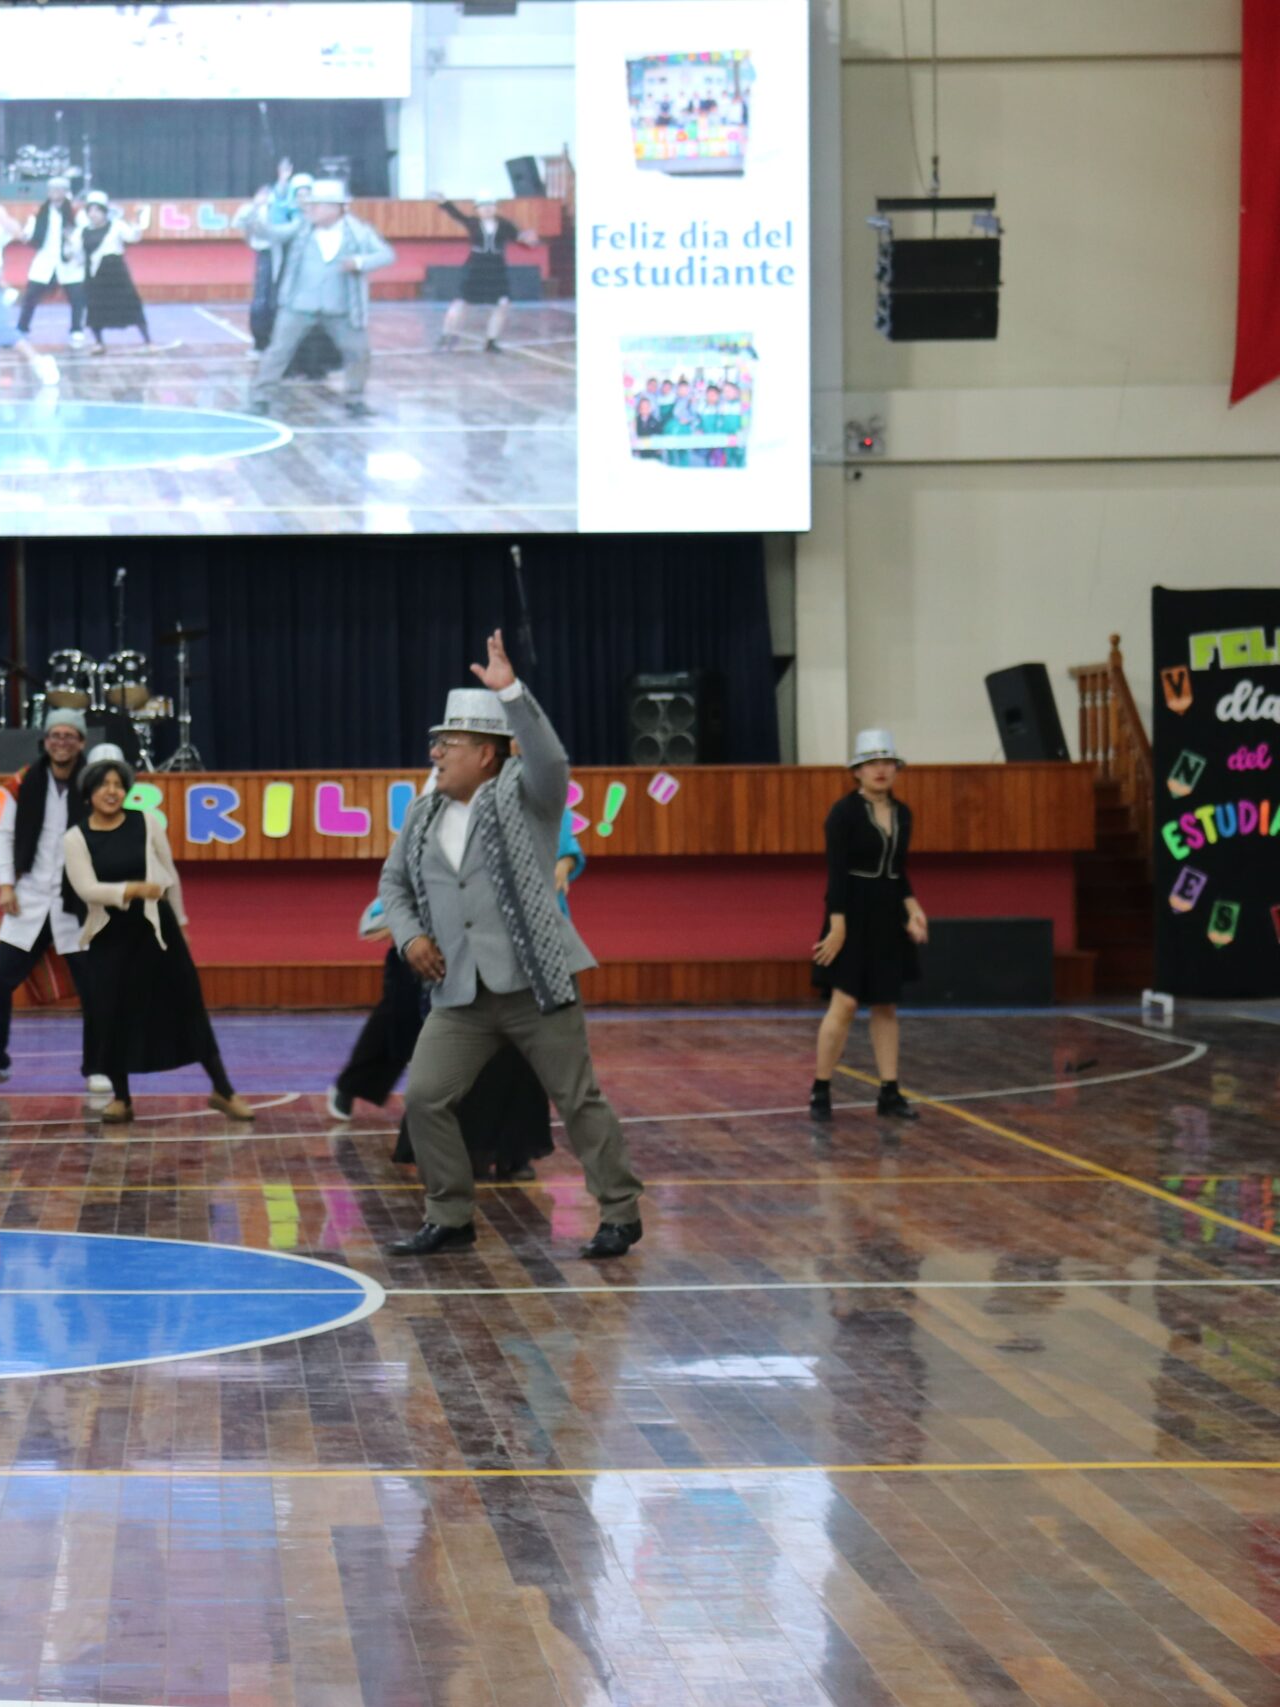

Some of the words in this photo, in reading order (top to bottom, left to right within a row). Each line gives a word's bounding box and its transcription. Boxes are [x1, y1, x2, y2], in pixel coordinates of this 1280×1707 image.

[591, 221, 666, 249] Feliz
[679, 220, 730, 249] día
[742, 220, 792, 249] del
[590, 255, 796, 287] estudiante
[1188, 626, 1280, 671] FEL
[1227, 742, 1273, 772] del
